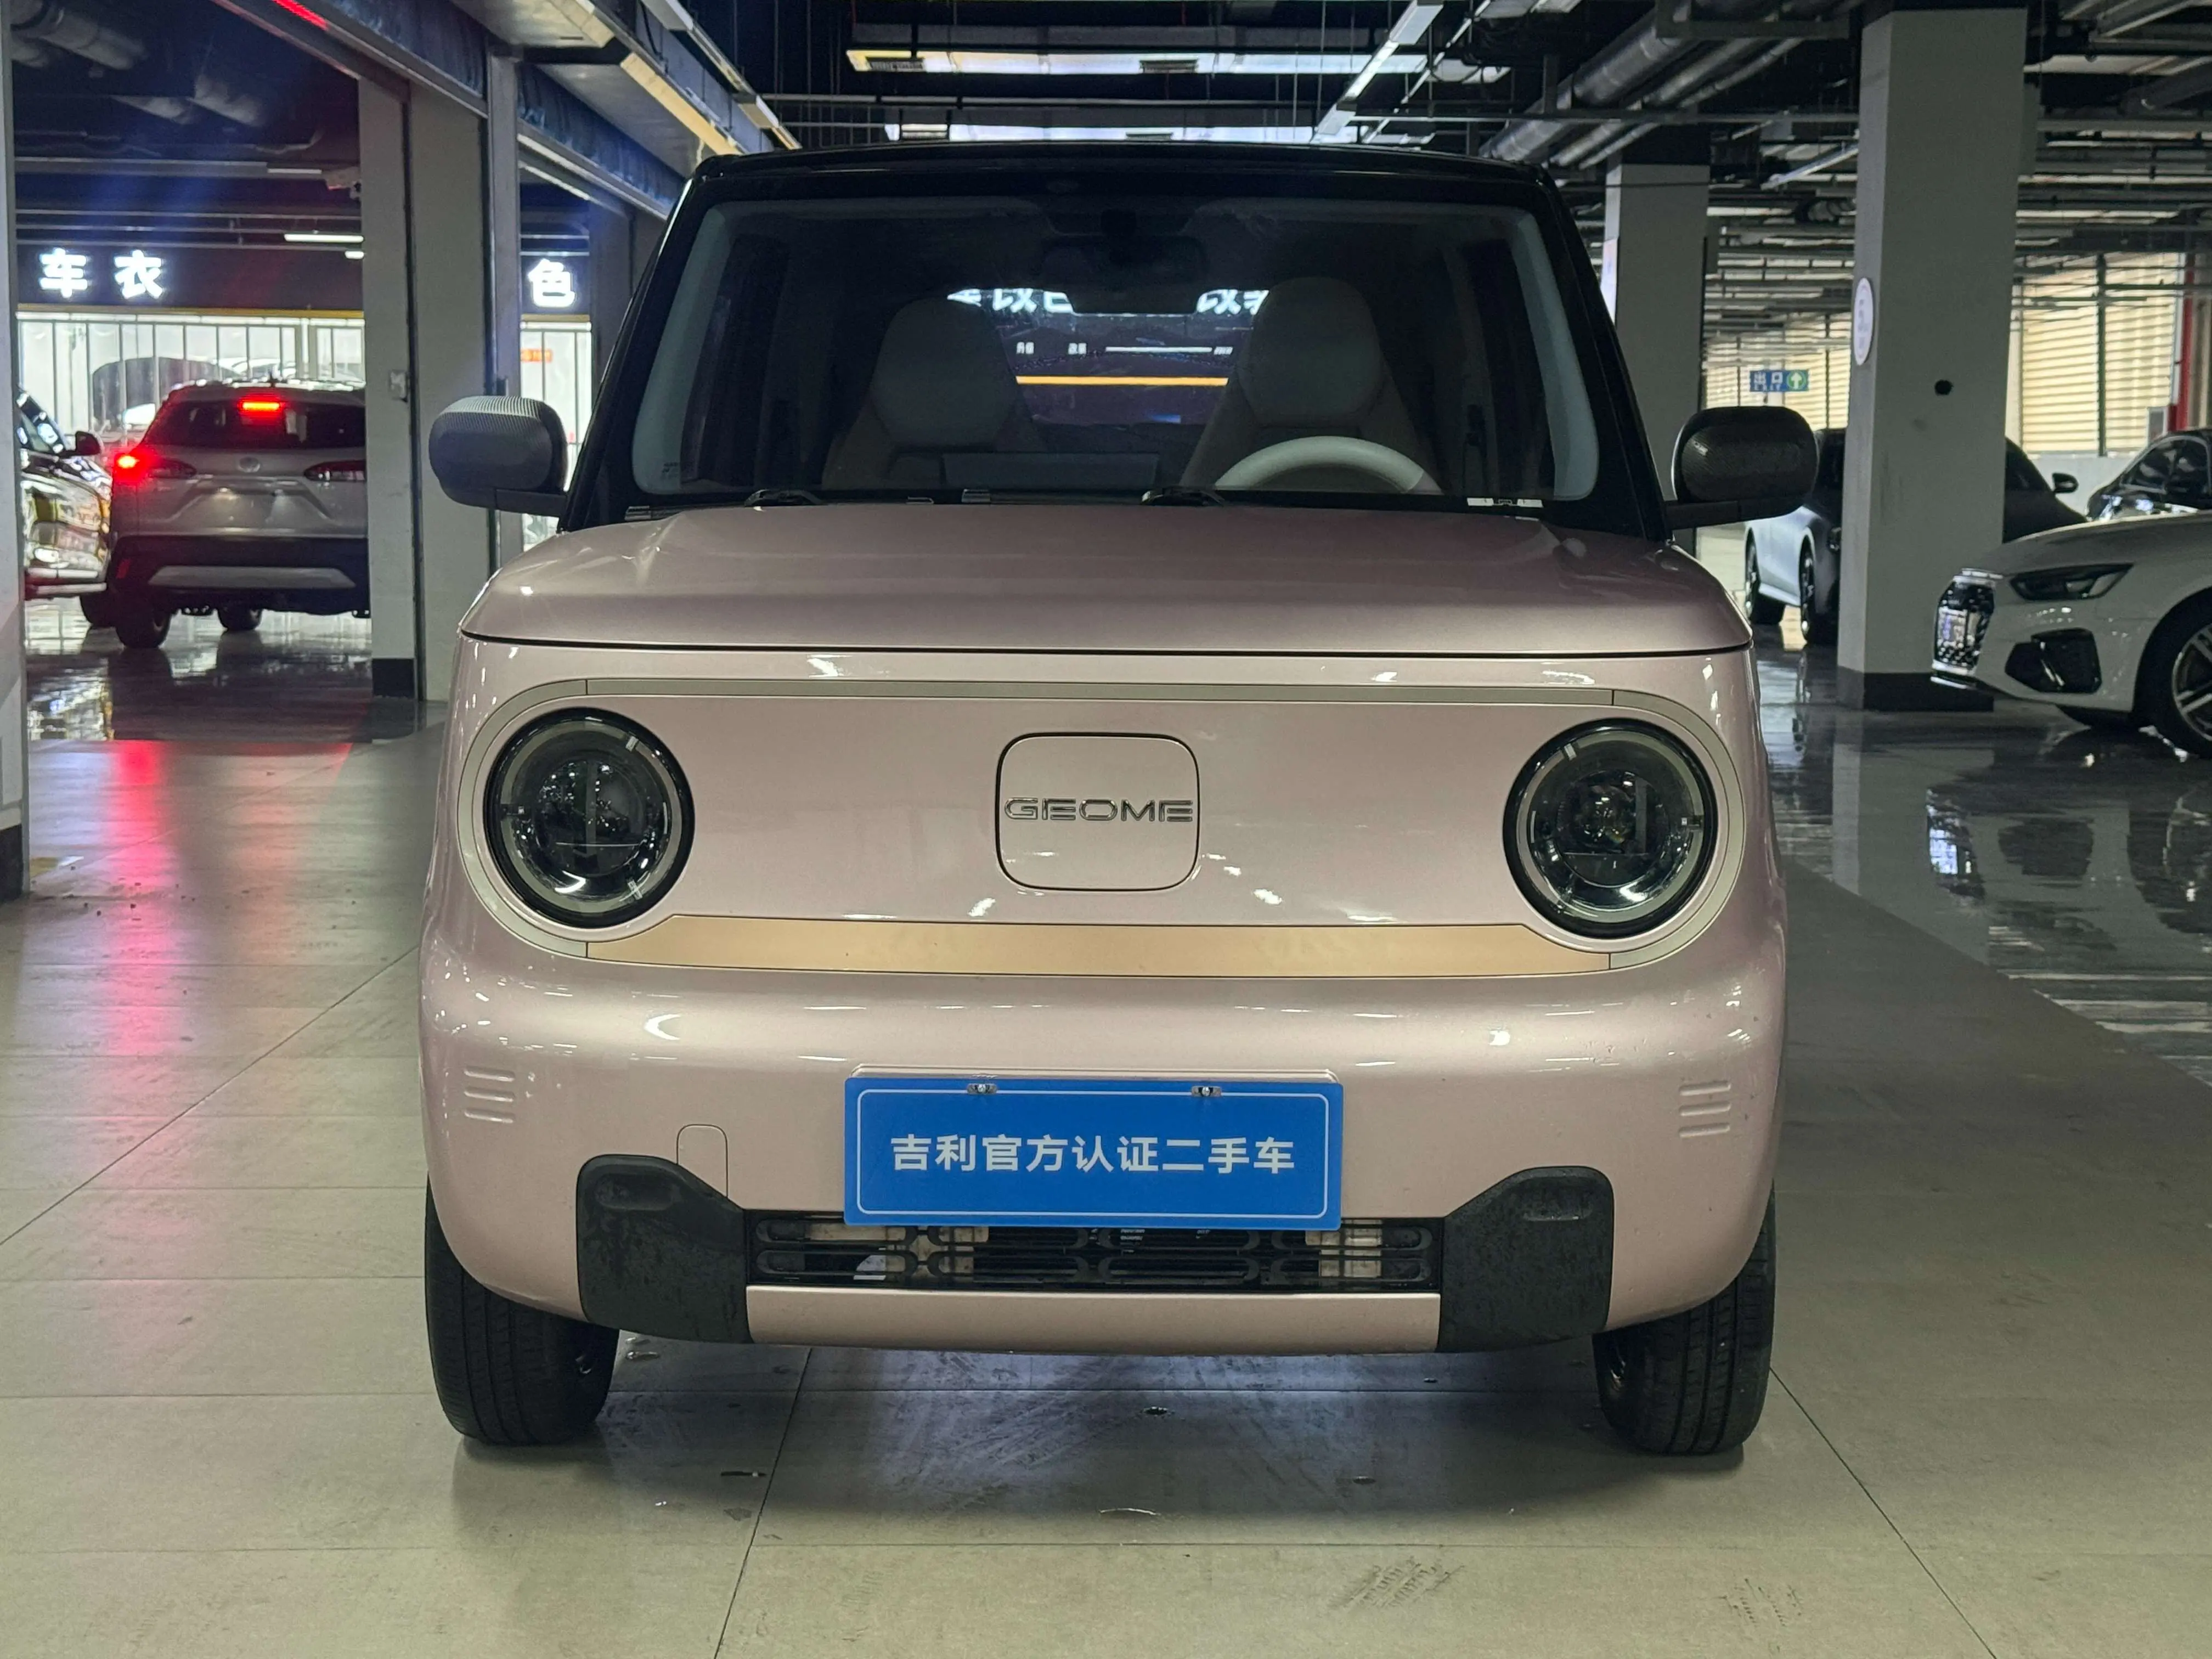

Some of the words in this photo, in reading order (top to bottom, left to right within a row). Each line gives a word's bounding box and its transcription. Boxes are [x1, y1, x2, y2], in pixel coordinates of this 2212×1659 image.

[40, 247, 163, 299] 车衣
[528, 258, 575, 308] 色
[1005, 797, 1193, 822] GEOME
[890, 1133, 1295, 1175] 吉利官方认证二手车
